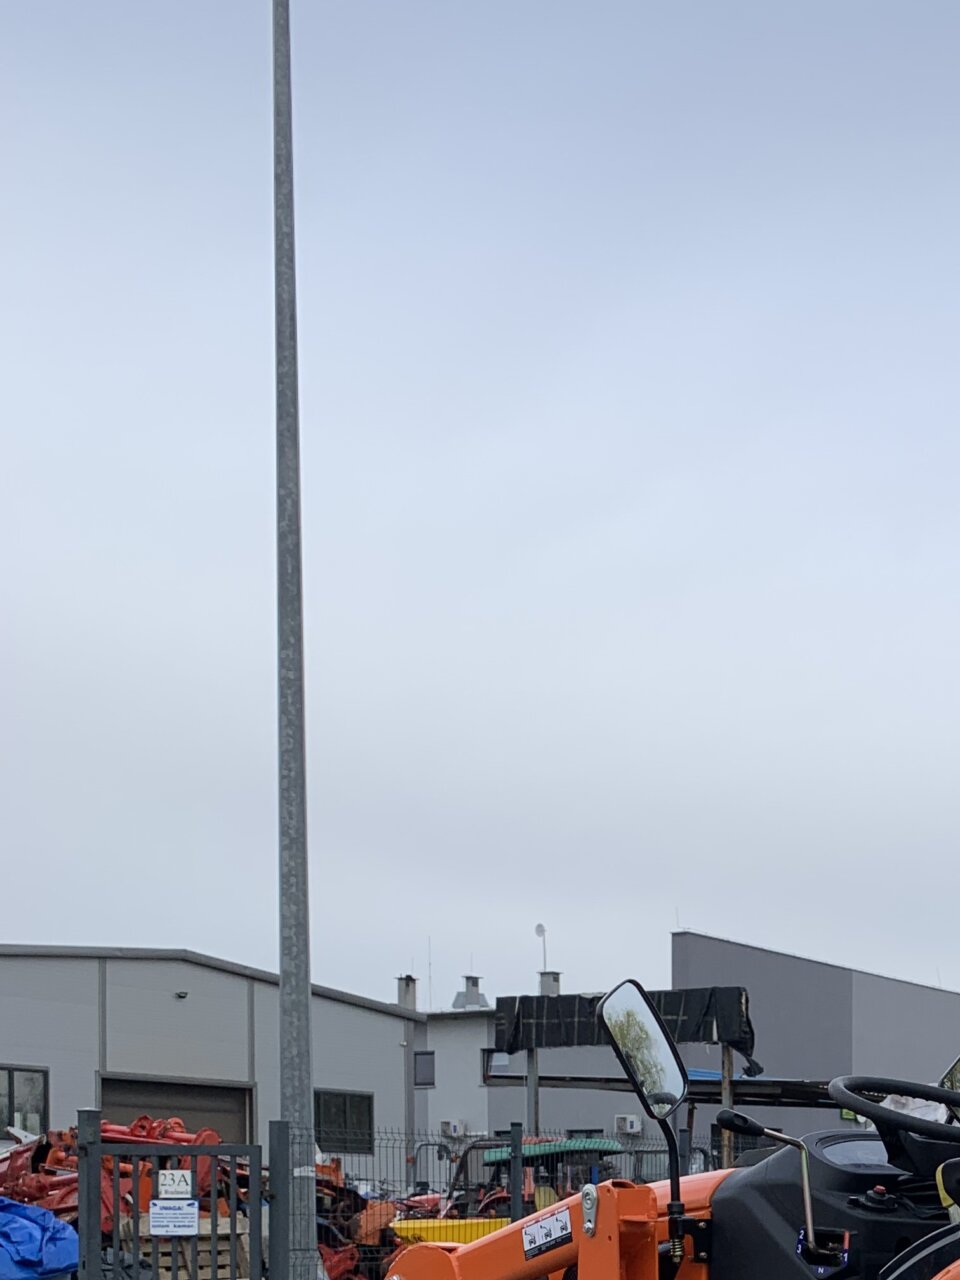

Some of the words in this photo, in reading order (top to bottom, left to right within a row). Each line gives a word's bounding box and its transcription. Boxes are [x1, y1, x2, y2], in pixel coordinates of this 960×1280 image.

[160, 1173, 189, 1187] 23A
[799, 1229, 804, 1239] 2
[796, 1244, 802, 1254] 3
[843, 1252, 848, 1262] 1
